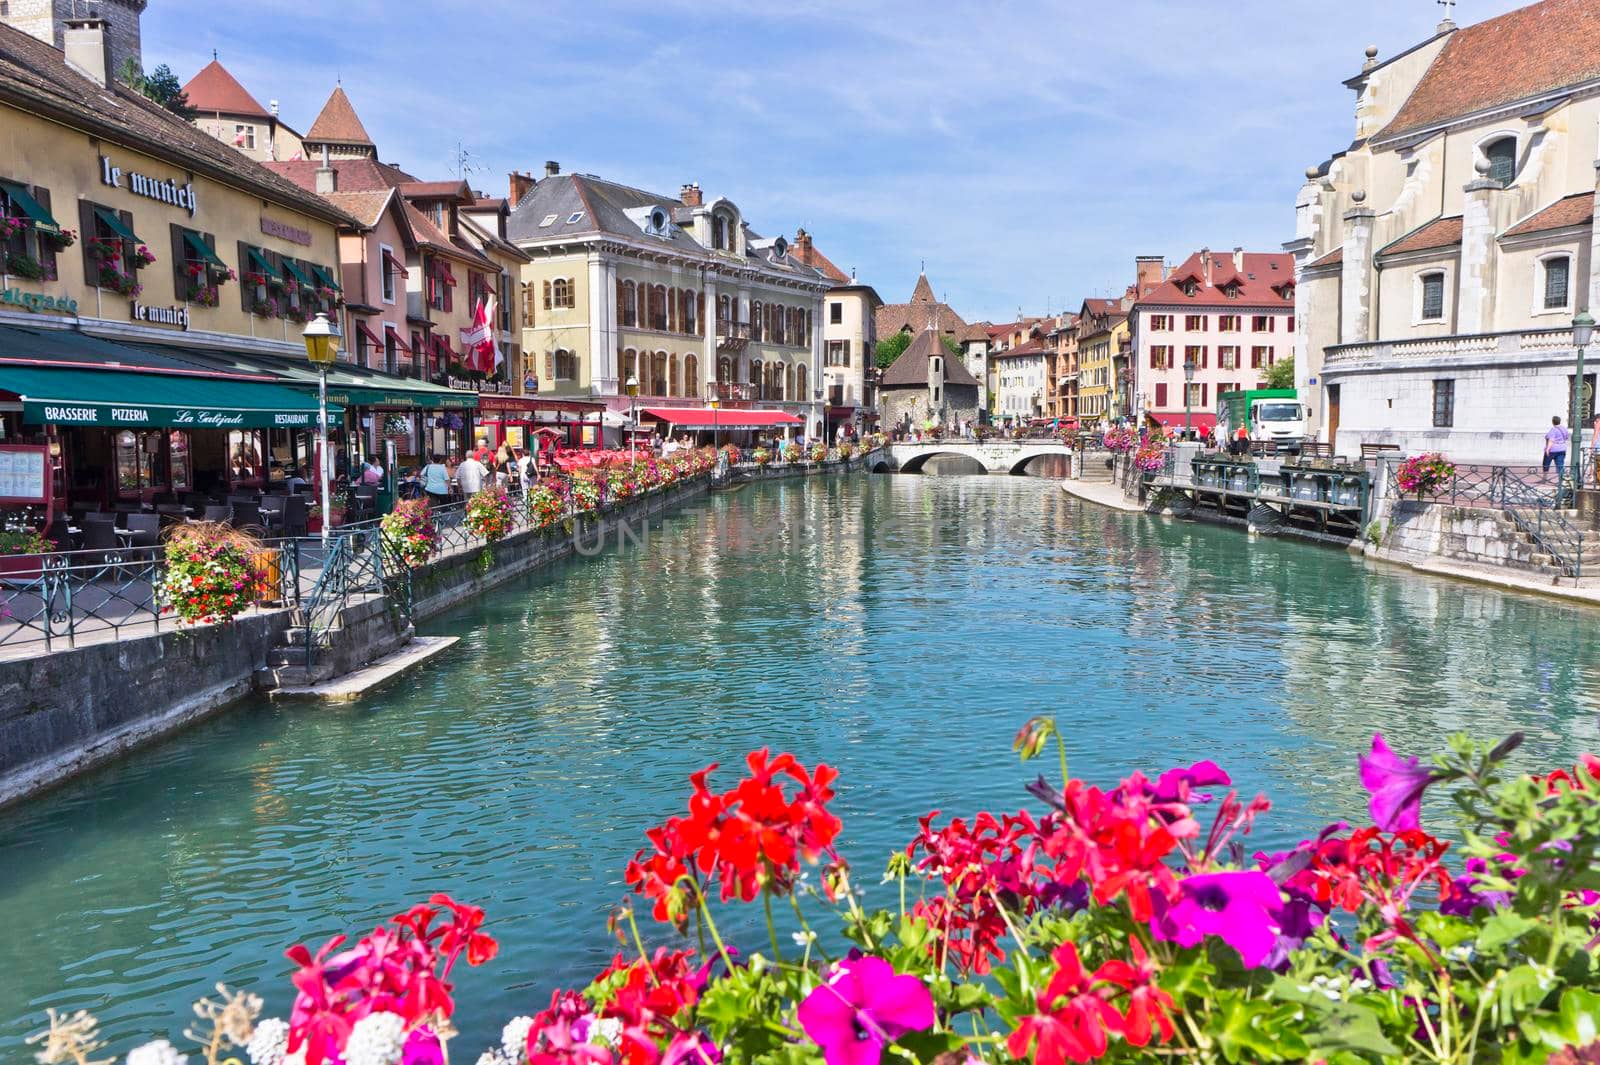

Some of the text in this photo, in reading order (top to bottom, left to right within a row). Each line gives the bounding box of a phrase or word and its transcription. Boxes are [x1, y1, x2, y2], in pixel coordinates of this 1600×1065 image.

[102, 156, 197, 217] le munich
[132, 301, 190, 331] le munich
[44, 406, 98, 422] BRASSERIE
[111, 408, 149, 422] PIZZERIA
[172, 409, 195, 423] La
[274, 414, 309, 424] RESTAURANT
